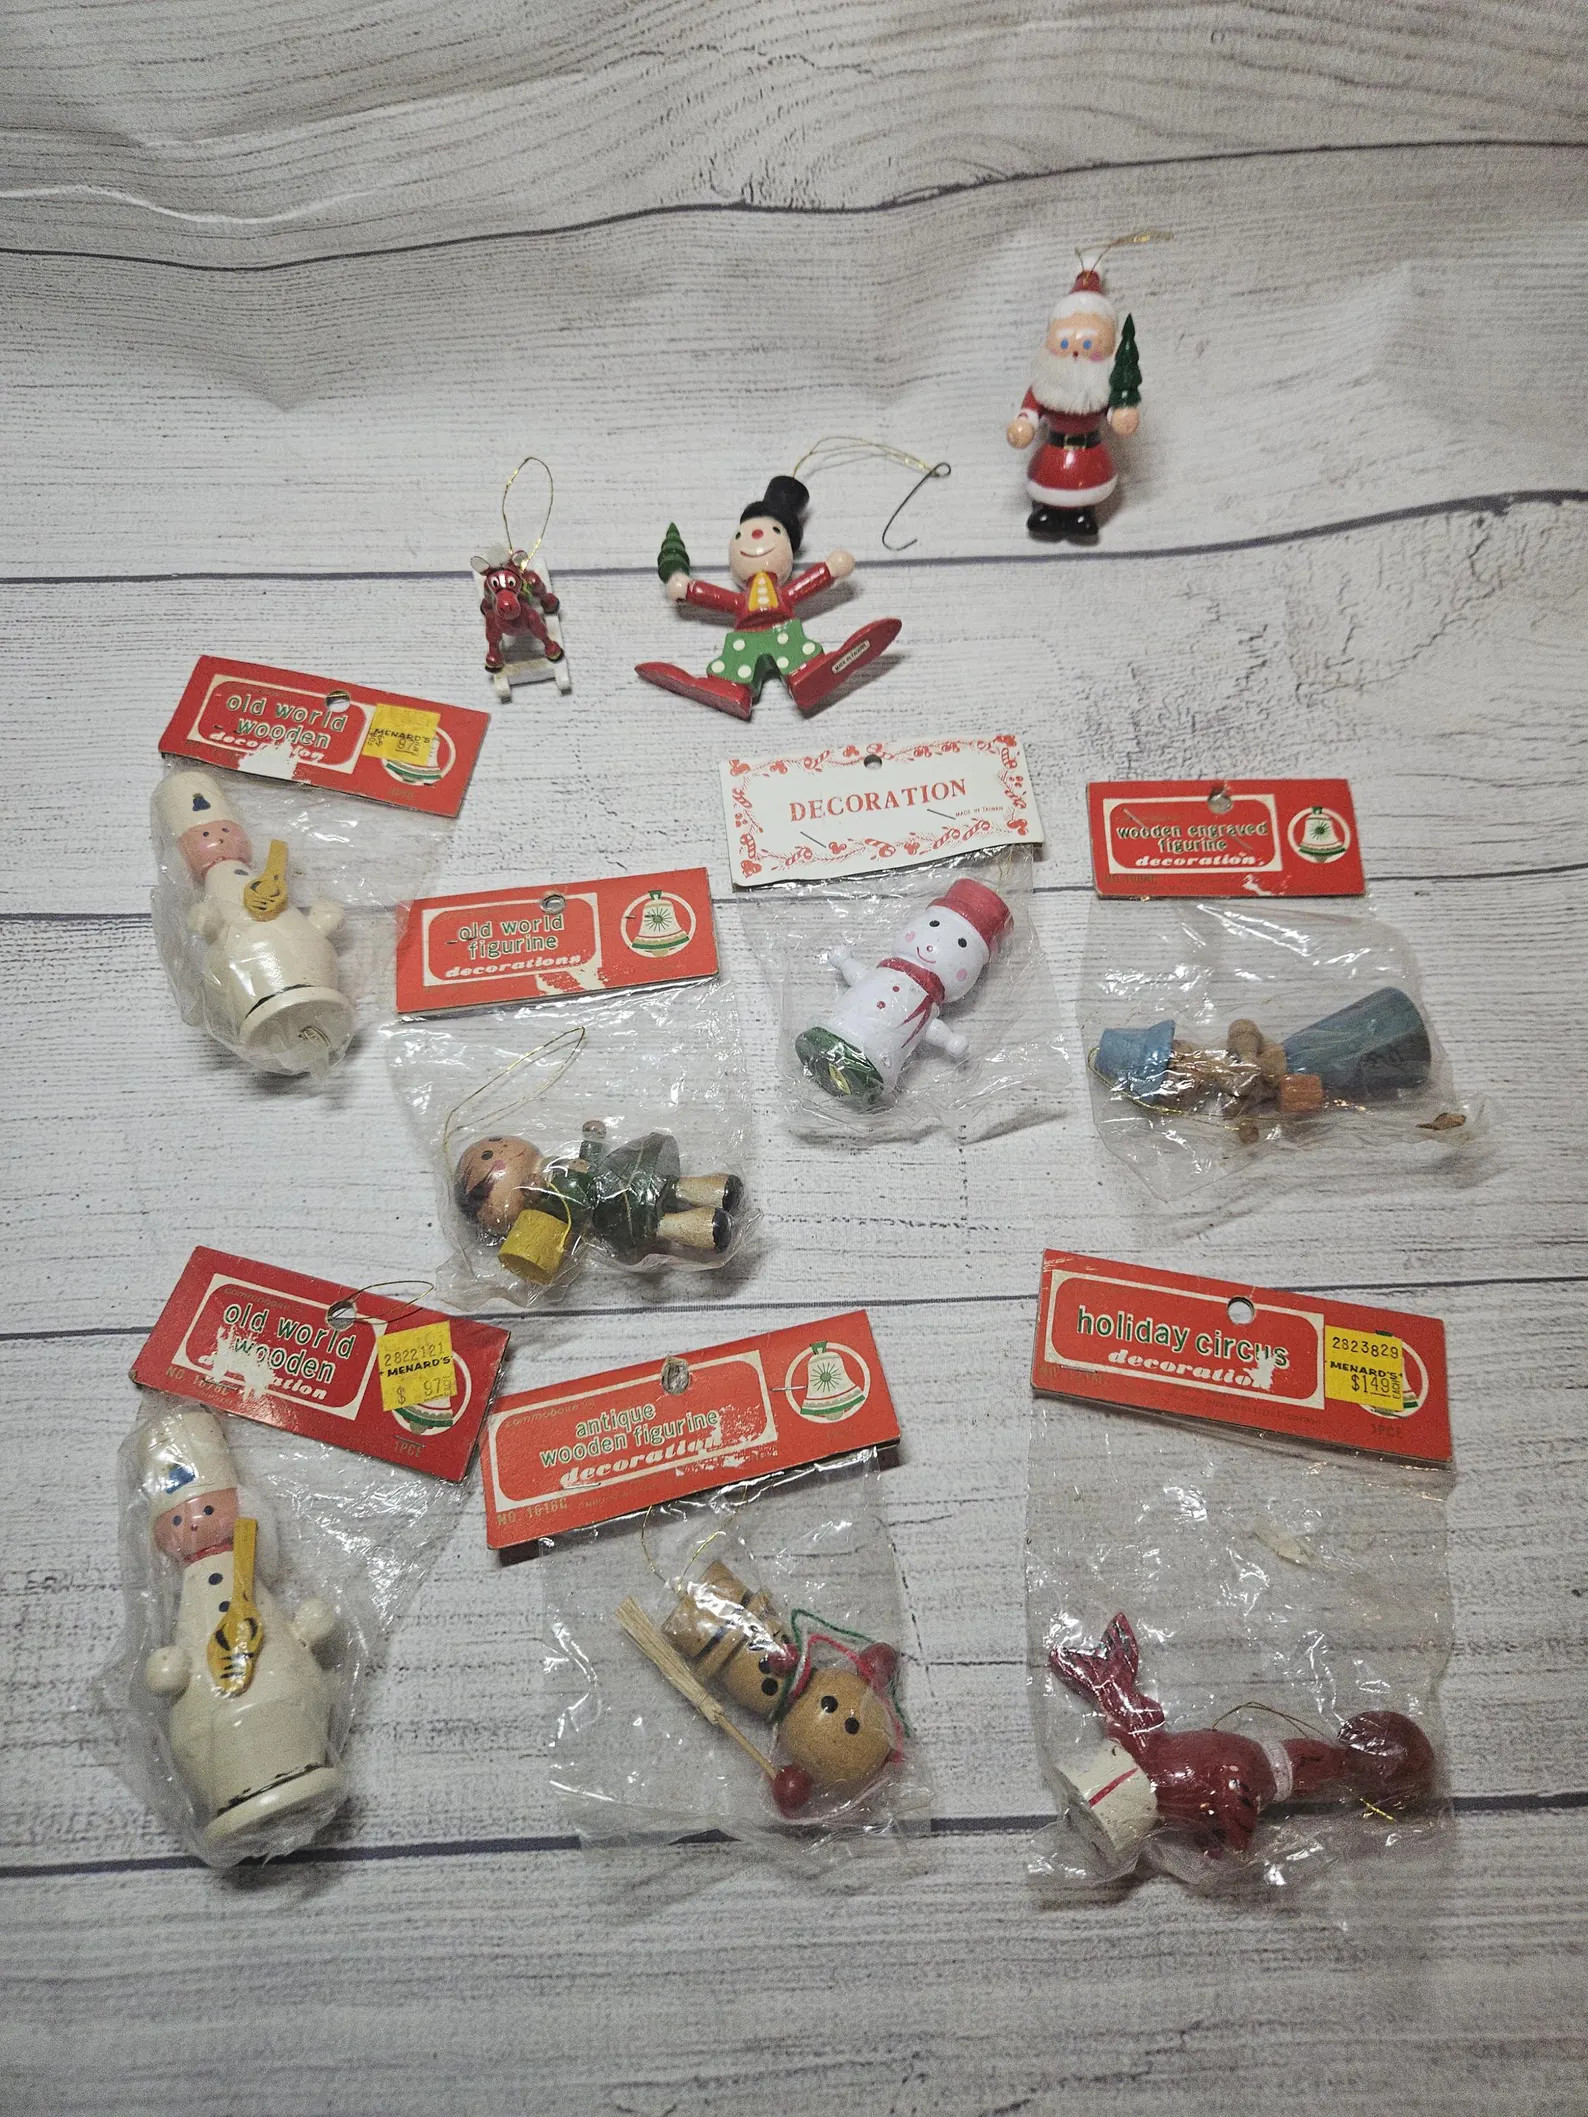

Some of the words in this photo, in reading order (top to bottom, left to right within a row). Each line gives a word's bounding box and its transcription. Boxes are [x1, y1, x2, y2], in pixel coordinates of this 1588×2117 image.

[226, 694, 266, 716] old
[275, 703, 348, 732] world
[237, 718, 331, 749] wooden
[374, 728, 431, 744] MENARD'S
[789, 778, 967, 822] DECORATION
[955, 809, 971, 817] MADE
[1116, 824, 1181, 840] wooden
[1188, 820, 1268, 839] engraved
[1157, 838, 1228, 854] figurine
[459, 921, 493, 942] old
[501, 913, 565, 936] world
[468, 935, 559, 960] figurine
[444, 954, 582, 978] decorations
[223, 1303, 270, 1333] old
[277, 1317, 356, 1359] world
[1076, 1304, 1190, 1353] holiday
[1195, 1330, 1290, 1369] circus
[234, 1335, 336, 1384] wooden
[384, 1341, 445, 1367] 2822121
[1332, 1336, 1399, 1359] 2823829
[387, 1356, 451, 1377] MENARD'S
[1330, 1361, 1398, 1380] MENARD'S
[575, 1403, 657, 1438] antique
[539, 1432, 629, 1468] wooden
[633, 1409, 720, 1447] figurine
